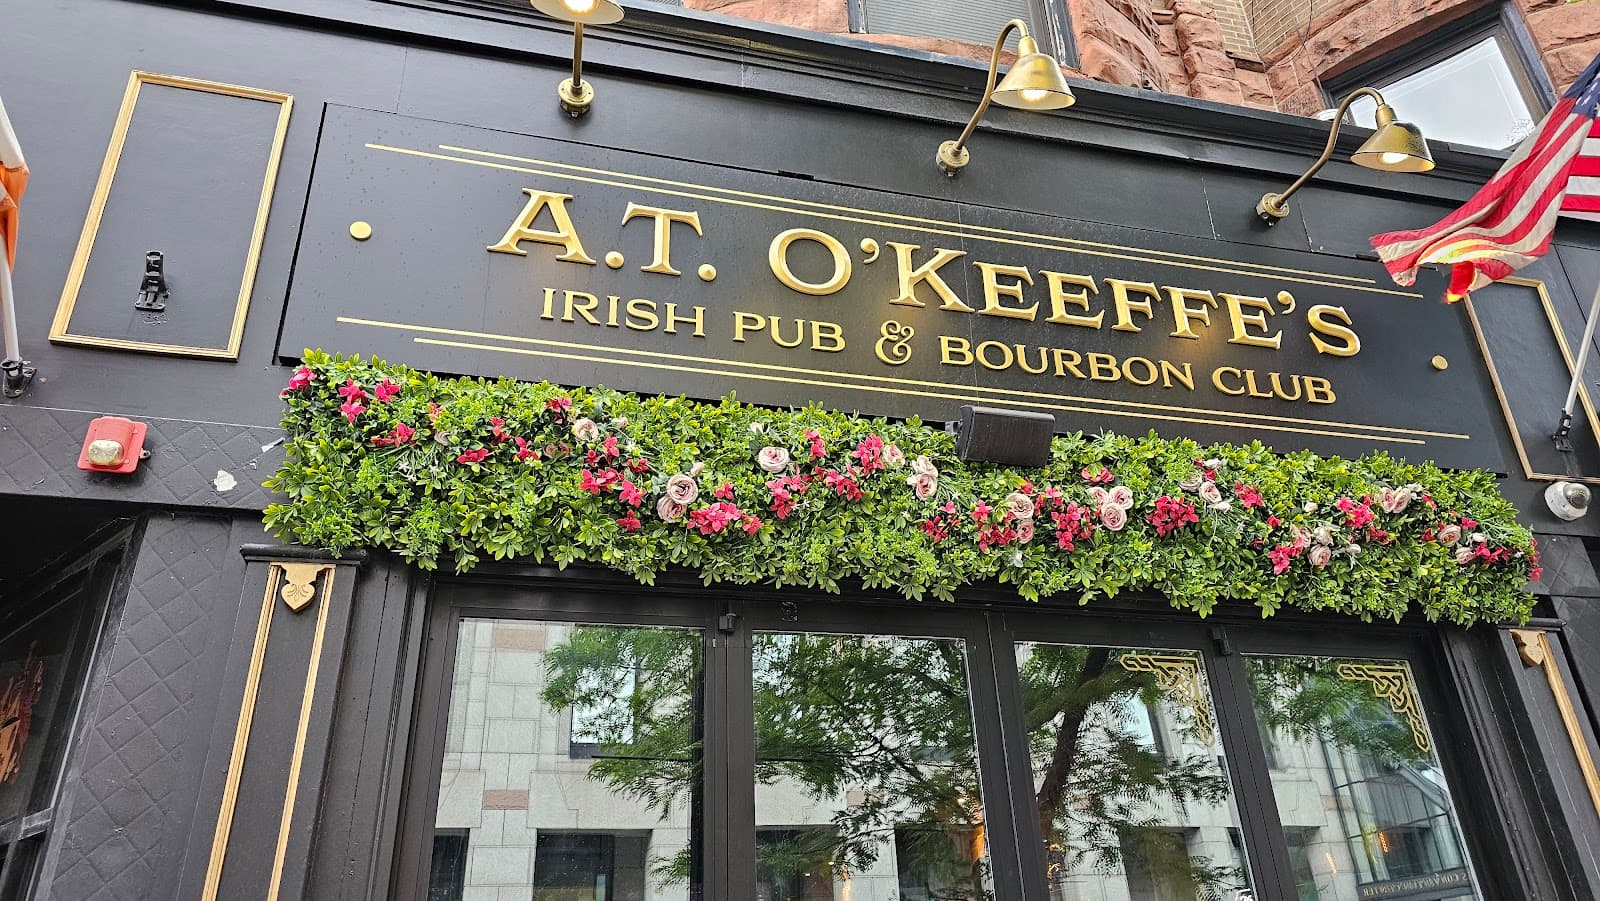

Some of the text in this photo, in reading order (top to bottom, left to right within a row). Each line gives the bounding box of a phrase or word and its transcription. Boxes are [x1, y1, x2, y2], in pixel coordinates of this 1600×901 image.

[486, 187, 1362, 358] A.T. O'KEEFFE'S
[540, 287, 1337, 405] IRISH PUB & BOURBON CLUB
